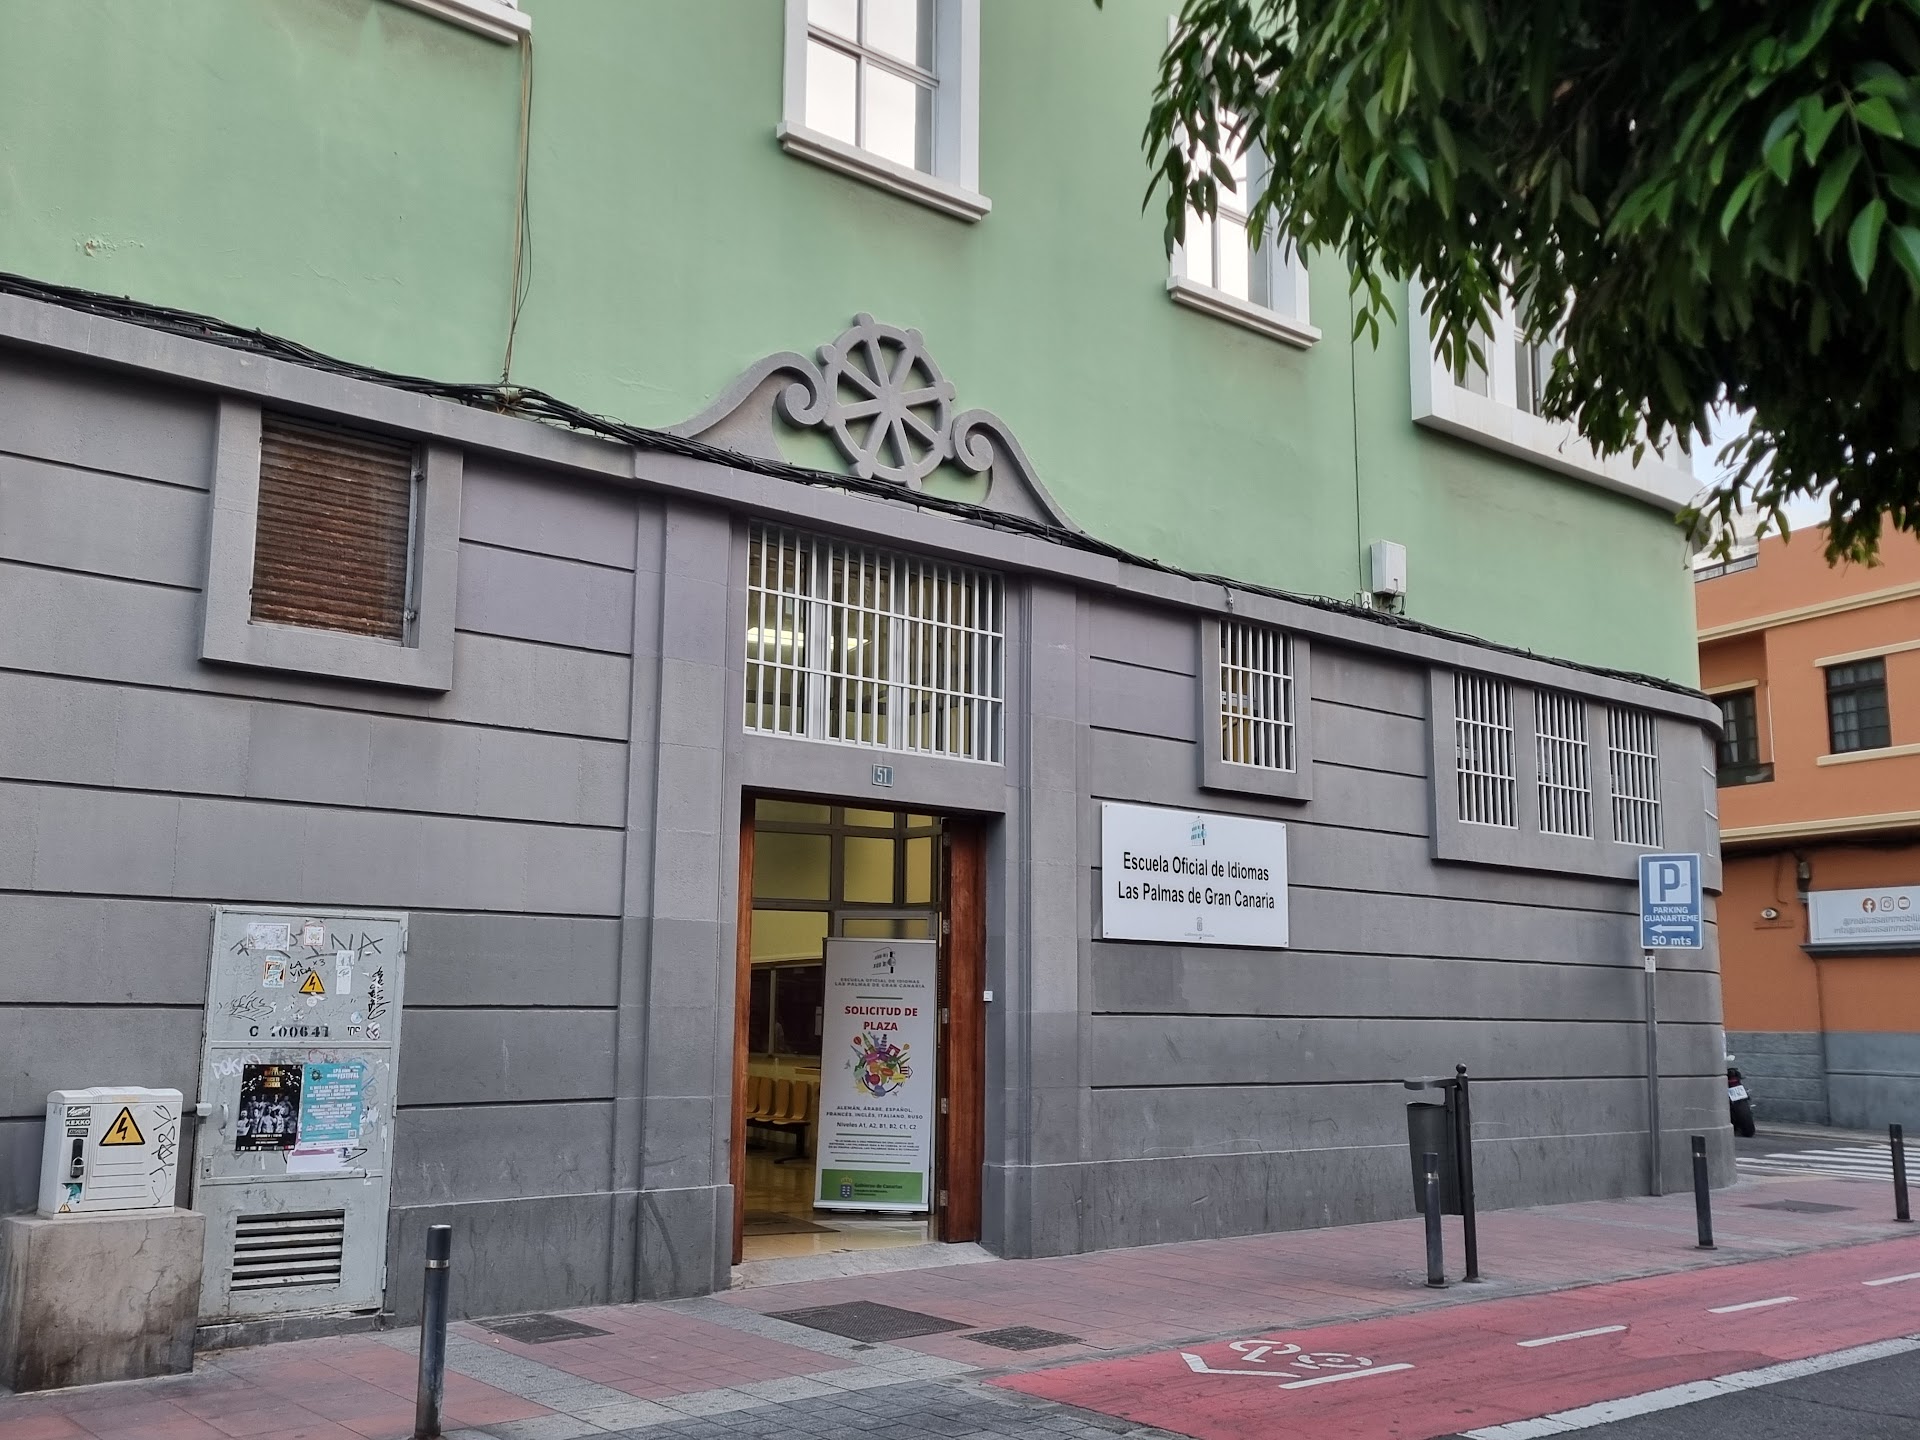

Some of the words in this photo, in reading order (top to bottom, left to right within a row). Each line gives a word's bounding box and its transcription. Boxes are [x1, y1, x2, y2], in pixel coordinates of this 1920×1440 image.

[878, 768, 887, 783] 51
[1123, 852, 1169, 873] Escuela
[1172, 856, 1208, 876] Oficial
[1211, 860, 1224, 877] de
[1228, 861, 1269, 881] Idiomas
[1659, 863, 1680, 902] P
[1118, 881, 1139, 900] Las
[1142, 882, 1184, 902] Palmas
[1188, 887, 1201, 904] de
[1204, 887, 1231, 906] Gran
[1234, 890, 1275, 909] Canaria
[1652, 936, 1666, 946] 50
[1670, 936, 1692, 946] mts
[844, 1006, 902, 1016] SOLICITUD
[904, 1008, 918, 1016] DE
[249, 1025, 259, 1037] C
[863, 1022, 898, 1031] PLAZA
